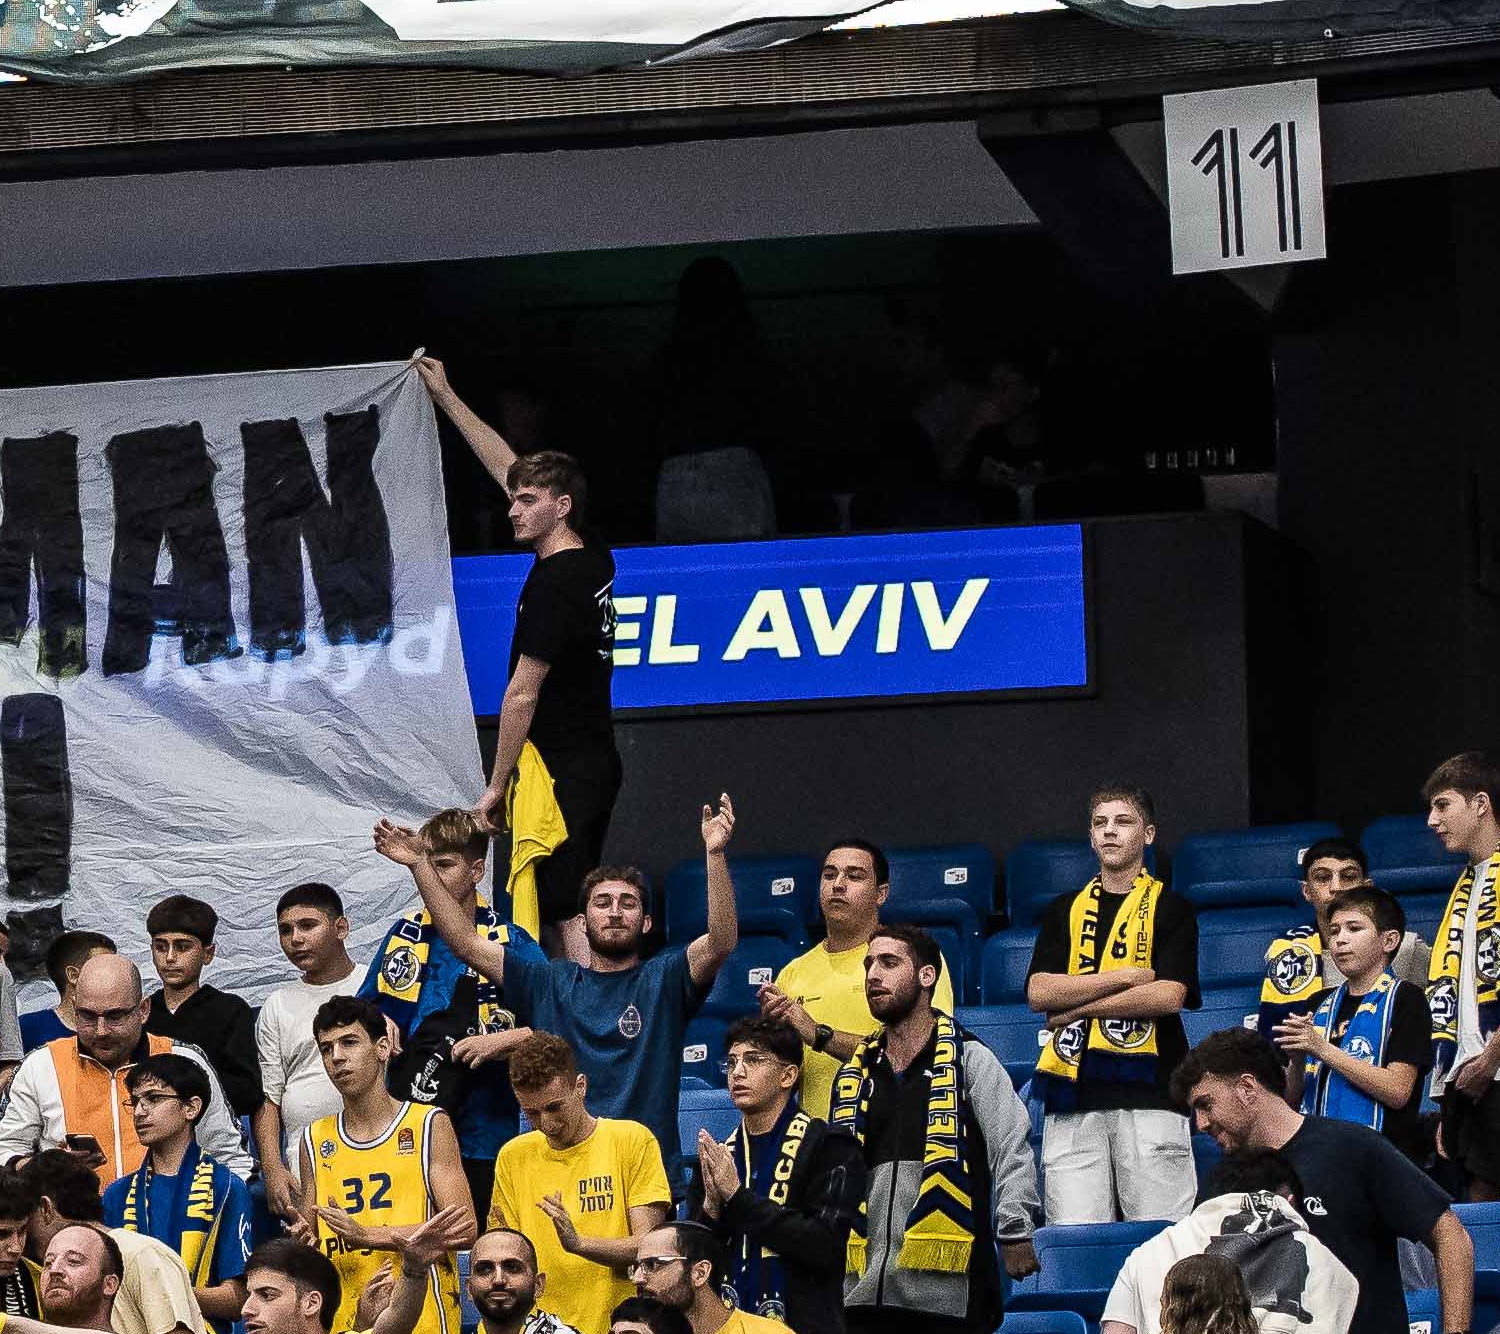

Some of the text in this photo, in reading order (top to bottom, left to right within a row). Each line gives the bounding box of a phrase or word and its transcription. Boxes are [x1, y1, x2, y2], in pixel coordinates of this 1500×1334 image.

[1192, 120, 1301, 257] 11
[610, 577, 990, 667] EL AVIV
[342, 1172, 392, 1216] 32
[767, 1111, 812, 1209] CCABI
